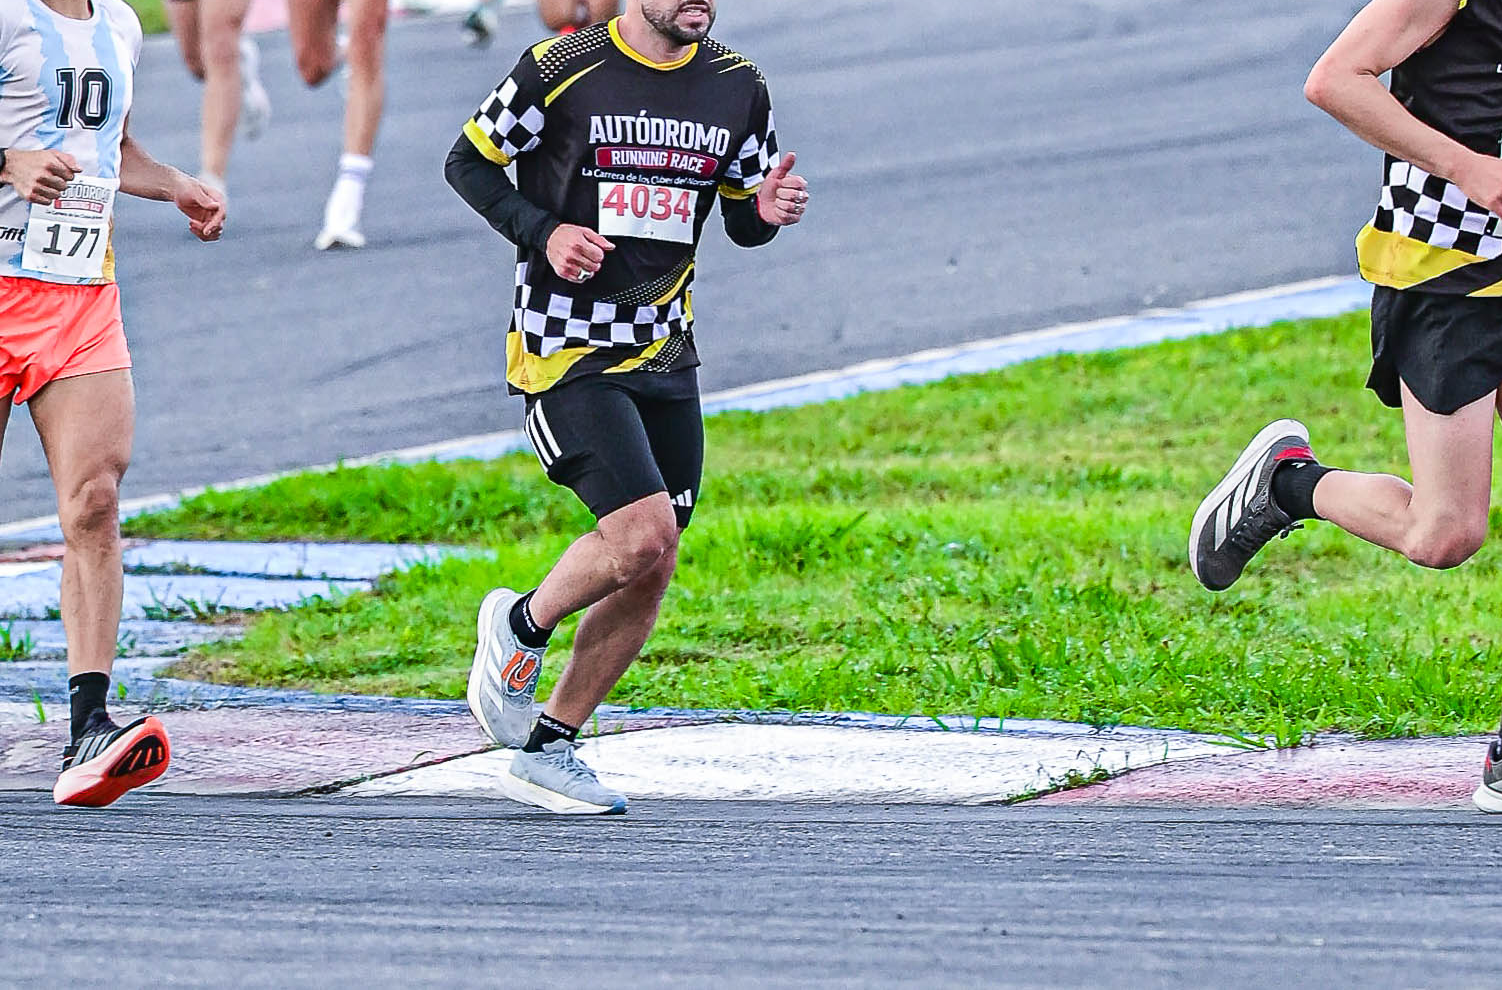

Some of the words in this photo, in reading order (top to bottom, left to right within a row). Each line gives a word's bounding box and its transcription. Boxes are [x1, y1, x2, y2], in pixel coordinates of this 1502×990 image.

[56, 67, 113, 130] 10
[589, 109, 731, 157] AUTÓDROMO
[581, 168, 593, 177] La
[594, 169, 625, 181] Carrera
[626, 172, 638, 182] de
[638, 174, 650, 184] los
[611, 150, 668, 167] RUNNING
[669, 152, 706, 173] RACE
[602, 184, 692, 223] 4034
[42, 224, 100, 258] 177
